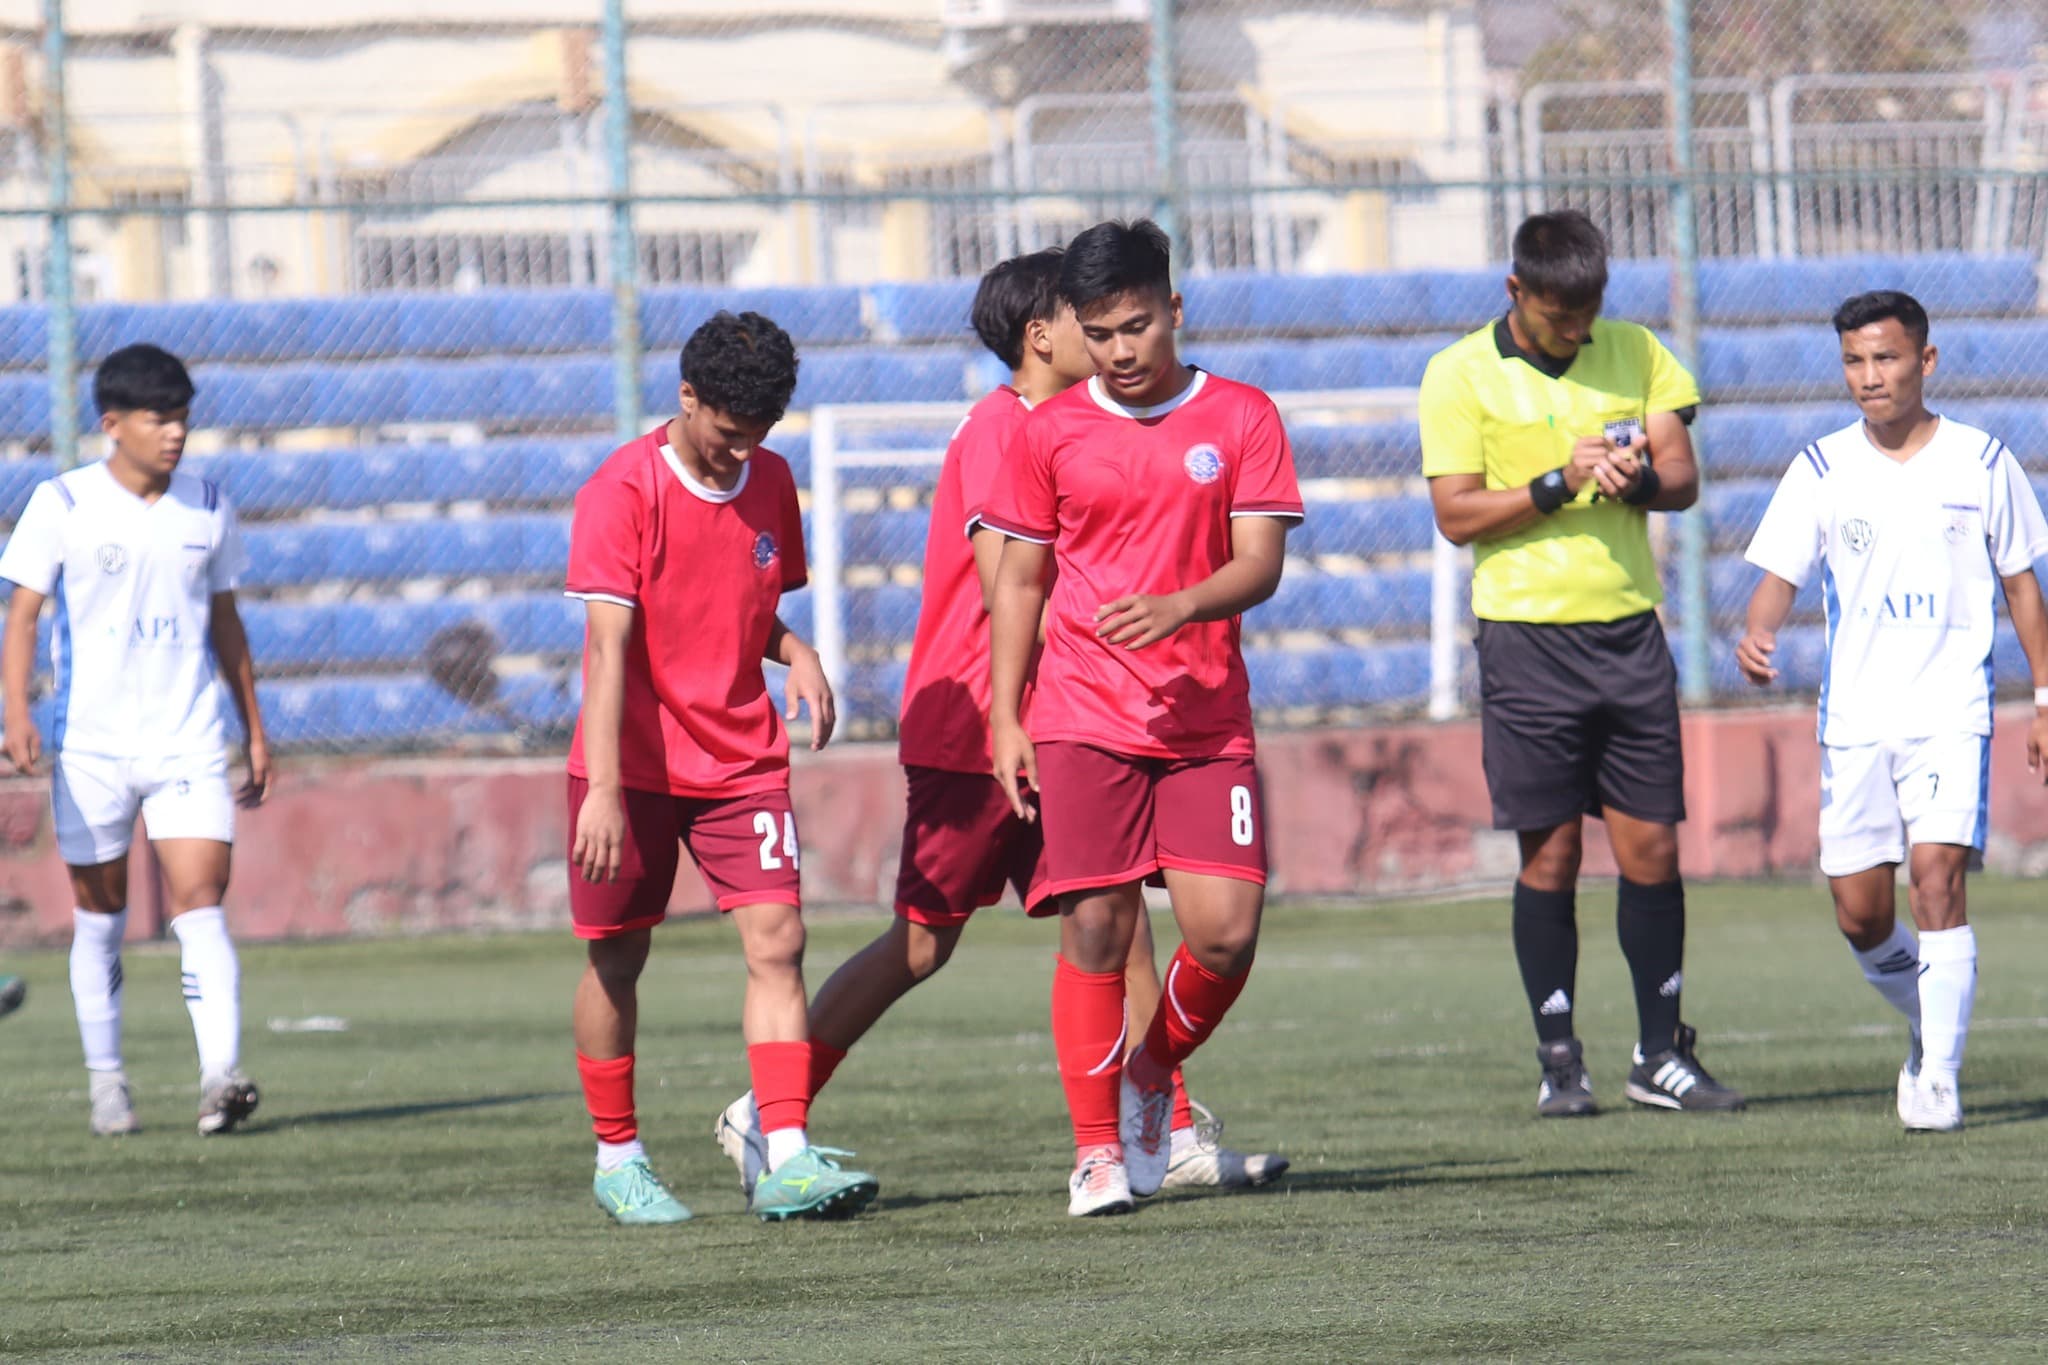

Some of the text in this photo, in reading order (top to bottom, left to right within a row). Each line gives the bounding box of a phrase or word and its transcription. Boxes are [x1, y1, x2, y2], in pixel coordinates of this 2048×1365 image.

[1878, 594, 1935, 619] API
[131, 616, 178, 639] API
[1927, 774, 1939, 801] 7
[1230, 785, 1253, 846] 8
[753, 811, 799, 870] 24
